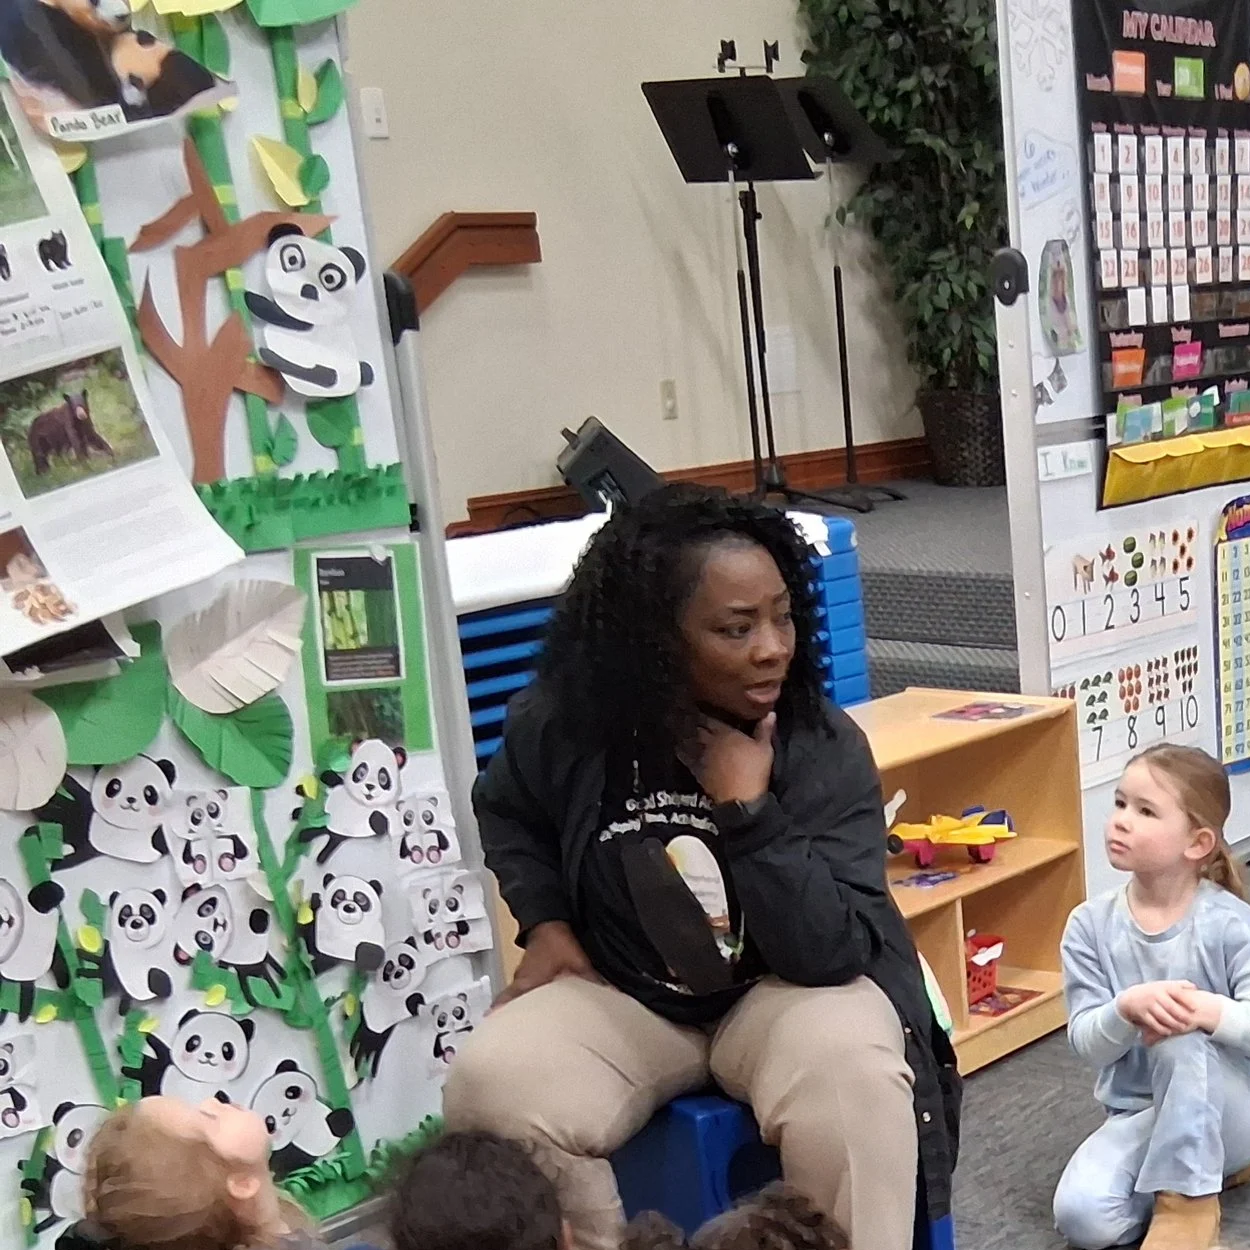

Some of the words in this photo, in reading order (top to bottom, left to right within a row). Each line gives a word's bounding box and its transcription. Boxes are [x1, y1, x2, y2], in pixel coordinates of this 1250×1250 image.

[1123, 9, 1149, 40] MY
[50, 116, 88, 133] Panda
[89, 109, 121, 130] Bear
[1052, 605, 1066, 642] 0
[1081, 599, 1086, 636] 1
[1103, 593, 1115, 630] 2
[1129, 588, 1140, 624] 3
[1154, 582, 1166, 617] 4
[1178, 576, 1190, 611] 5
[1092, 725, 1103, 761] 7
[1127, 715, 1138, 749] 8
[1155, 705, 1166, 737] 9
[1179, 694, 1198, 731] 10
